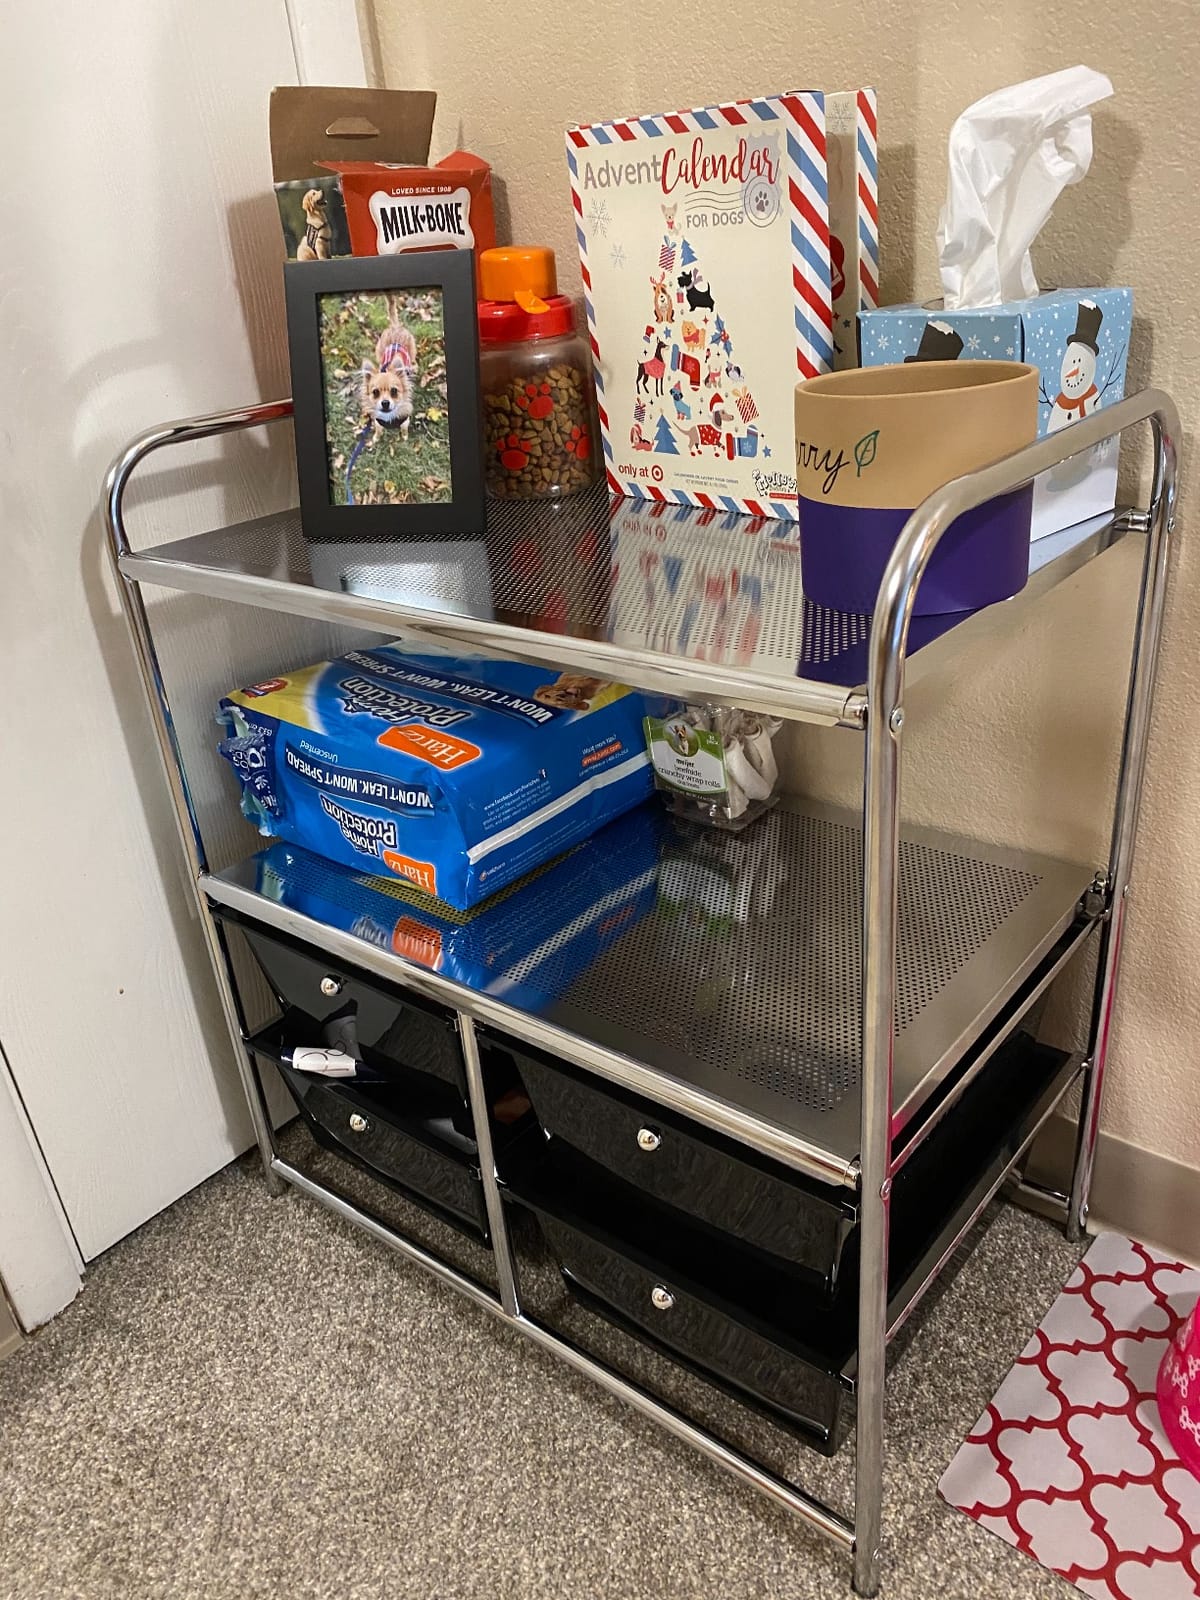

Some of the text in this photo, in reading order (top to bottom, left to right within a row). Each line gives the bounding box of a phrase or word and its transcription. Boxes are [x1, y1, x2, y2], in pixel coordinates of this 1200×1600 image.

[583, 136, 780, 195] Advent Calendar
[391, 187, 414, 195] LOVED
[415, 186, 436, 194] SINCE
[686, 211, 744, 229] FOR DOGS
[618, 463, 649, 479] only at
[391, 669, 448, 690] WON'T
[342, 678, 466, 726] Protection
[492, 694, 553, 723] WON'T
[299, 740, 339, 764] Unscented
[397, 729, 467, 764] Hartz
[285, 749, 434, 808] WON'T LEAK. WON'T SPREAD.
[321, 798, 396, 847] Protection
[342, 826, 379, 856] Home
[389, 860, 430, 888] Hartz
